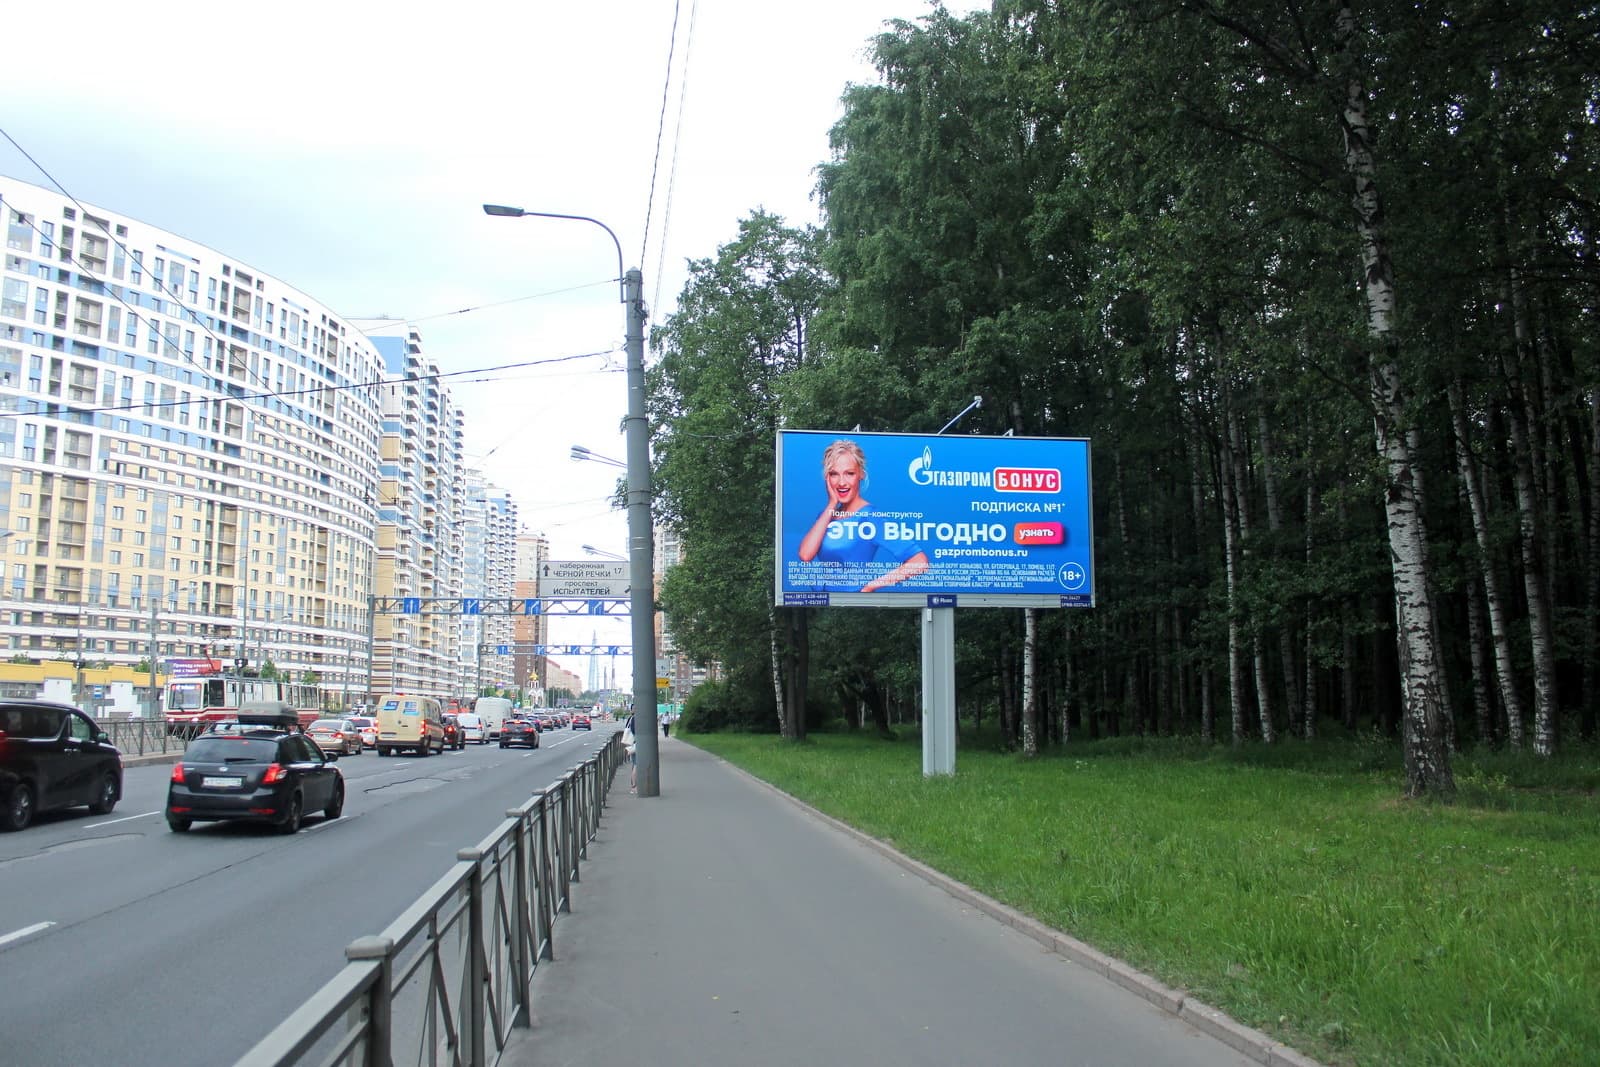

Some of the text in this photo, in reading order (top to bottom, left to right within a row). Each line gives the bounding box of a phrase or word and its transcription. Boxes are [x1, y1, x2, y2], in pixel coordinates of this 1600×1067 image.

[933, 471, 1056, 488] ГАЗПРОМ БОНУС
[971, 501, 1042, 514] ПОДПИСКА
[829, 509, 924, 519] Подписка-конструктор
[827, 521, 1007, 545] ЭТО ВЫГОДНО
[1019, 528, 1054, 540] узнать
[934, 548, 1028, 558] gazprombonus.ru
[560, 562, 605, 570] набережная
[553, 569, 611, 578] ЧЕРНОЙ РЕЧКИ
[1062, 571, 1081, 581] 18+
[553, 586, 610, 595] ИСПЫТАТЕЛЕЙ
